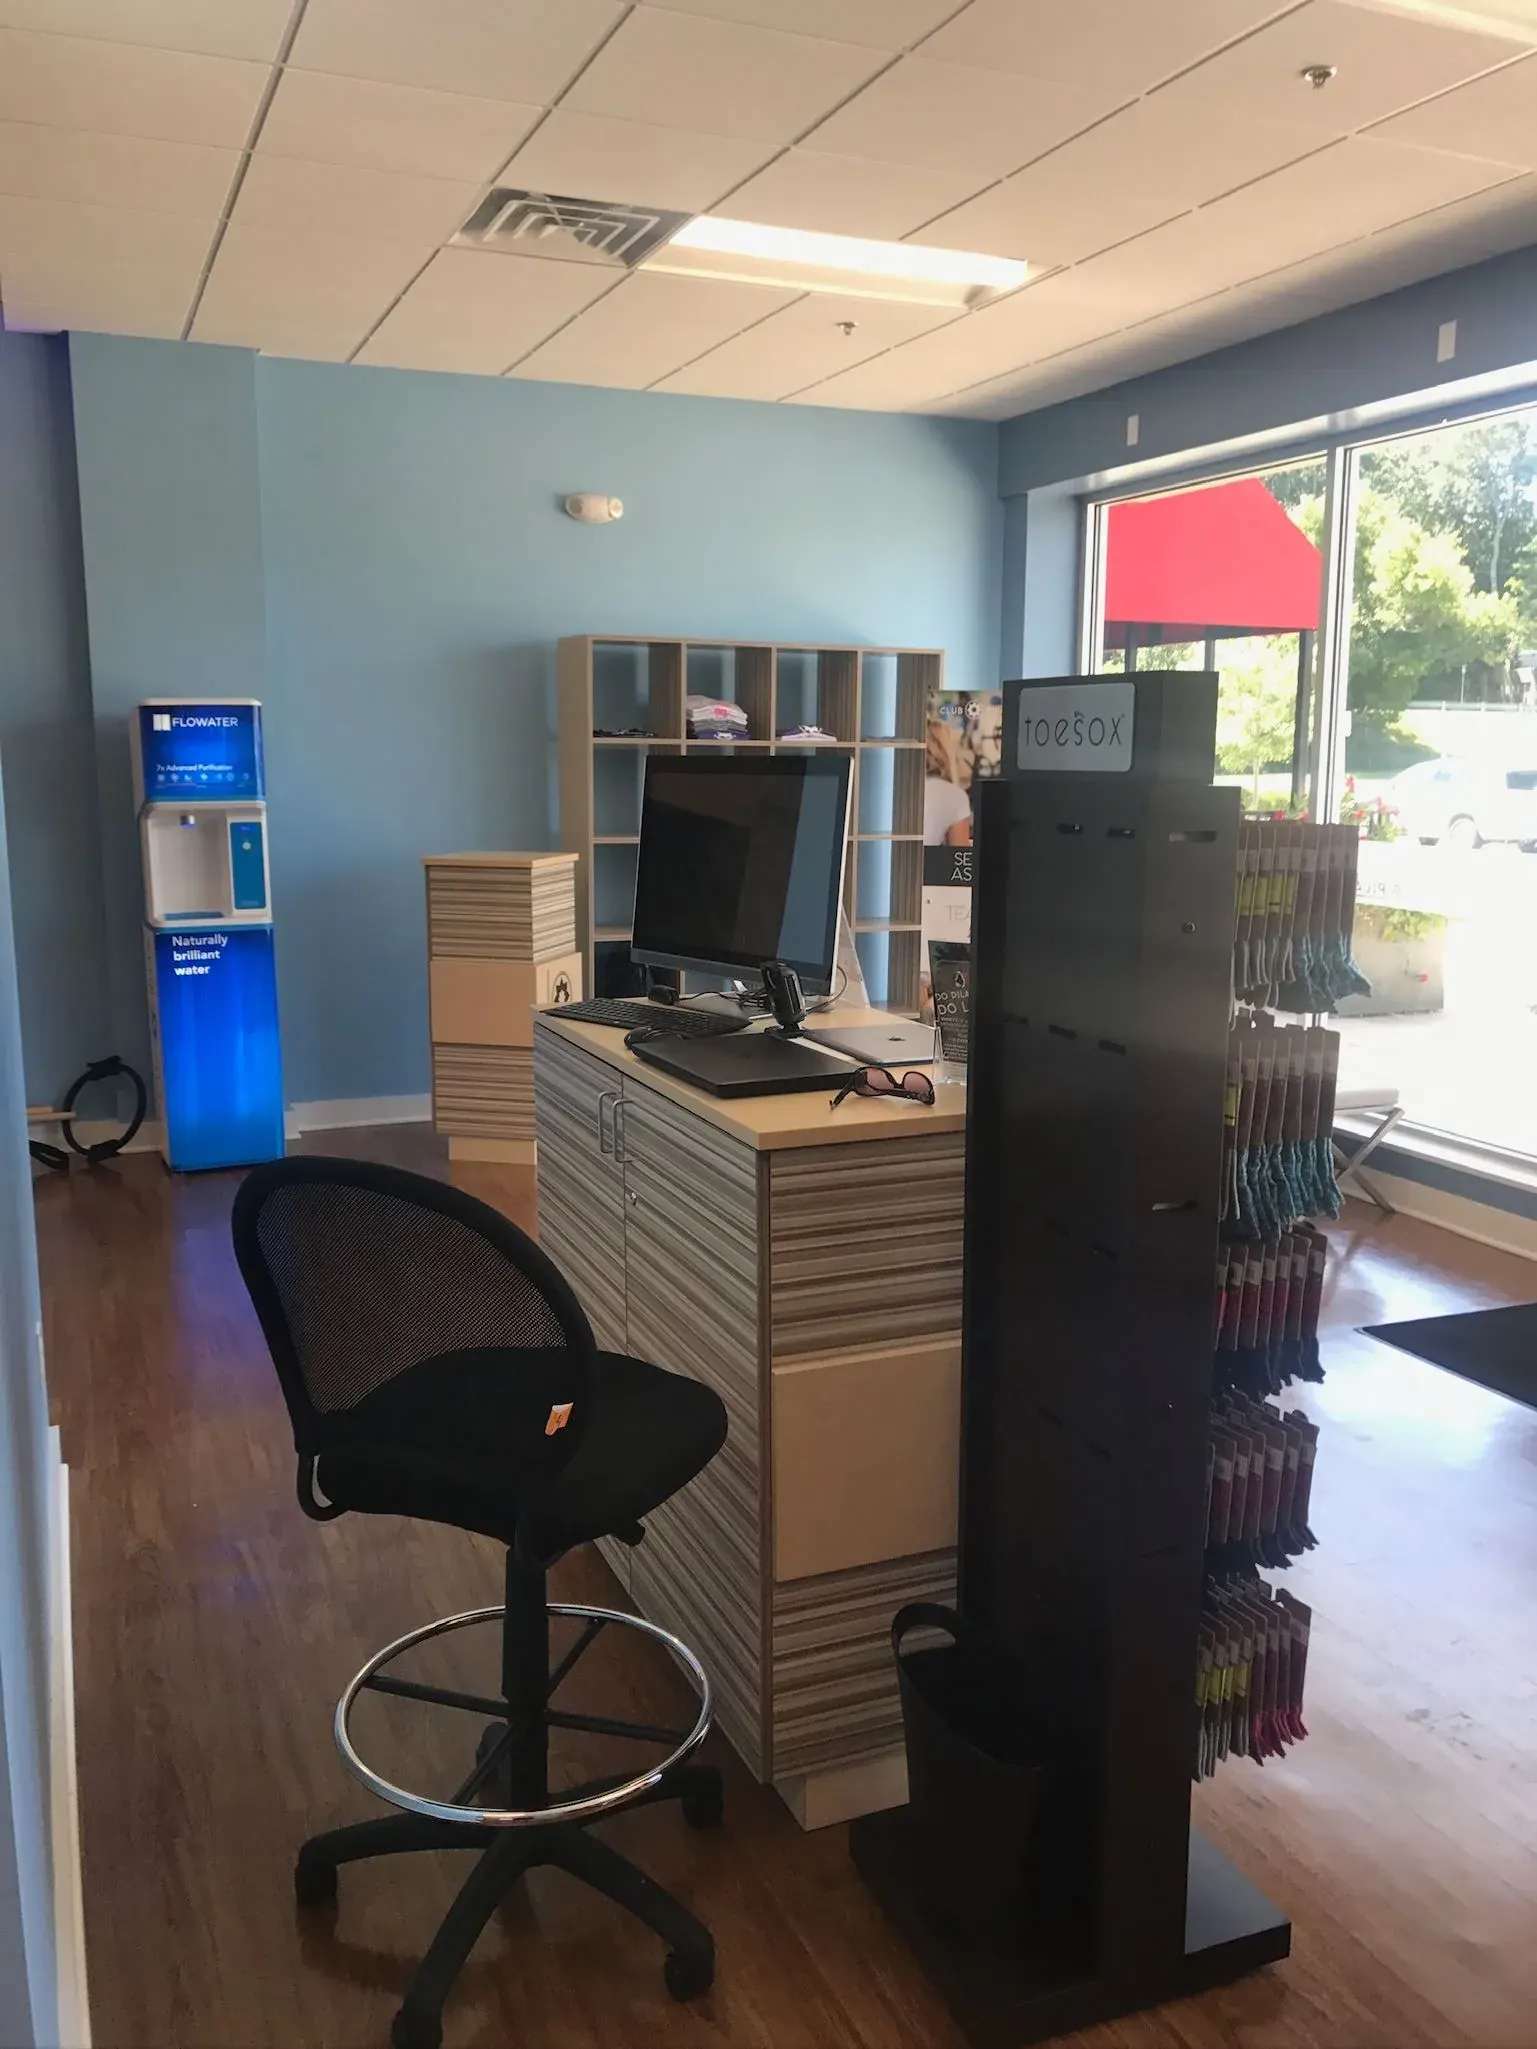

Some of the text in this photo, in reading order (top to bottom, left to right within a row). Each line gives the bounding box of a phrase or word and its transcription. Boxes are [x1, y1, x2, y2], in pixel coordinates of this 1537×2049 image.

[940, 706, 963, 715] CLUB
[172, 717, 238, 728] FLOWATER
[172, 934, 228, 947] Naturally
[173, 949, 220, 961] brilliant
[174, 965, 210, 975] water
[937, 1003, 957, 1015] DO
